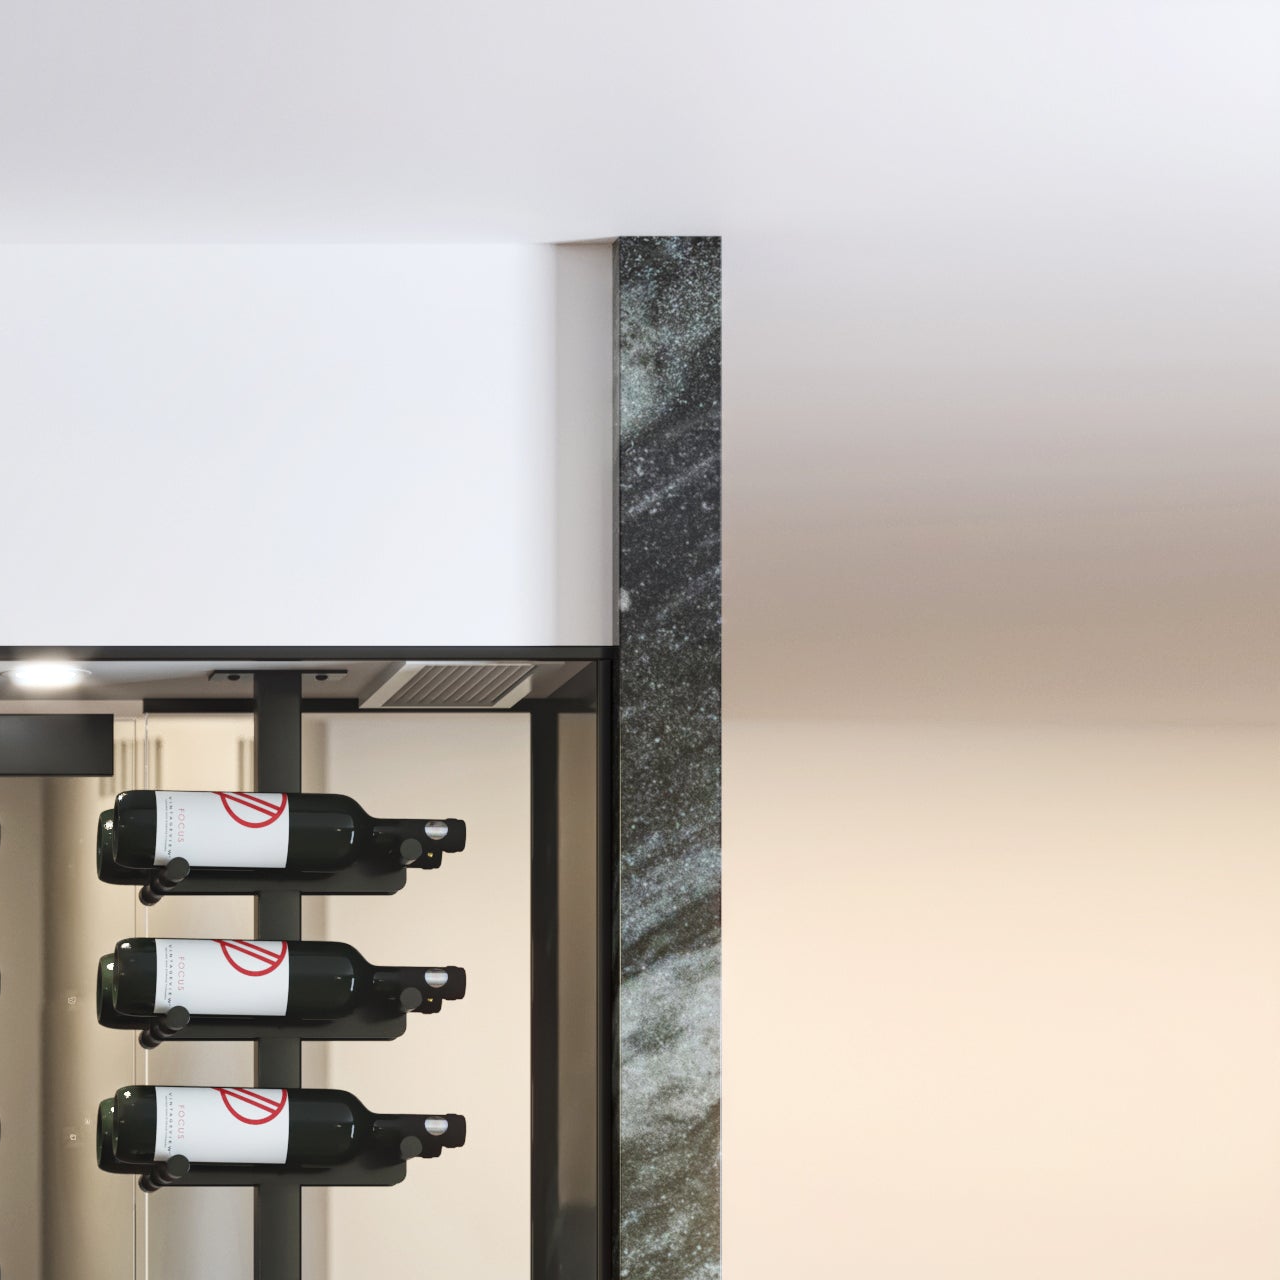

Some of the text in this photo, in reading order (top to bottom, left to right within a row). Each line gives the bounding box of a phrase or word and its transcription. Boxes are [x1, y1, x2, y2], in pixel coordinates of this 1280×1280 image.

[177, 808, 185, 843] FOCUS
[177, 956, 185, 991] FOCUS
[177, 1104, 185, 1139] FOCUS
